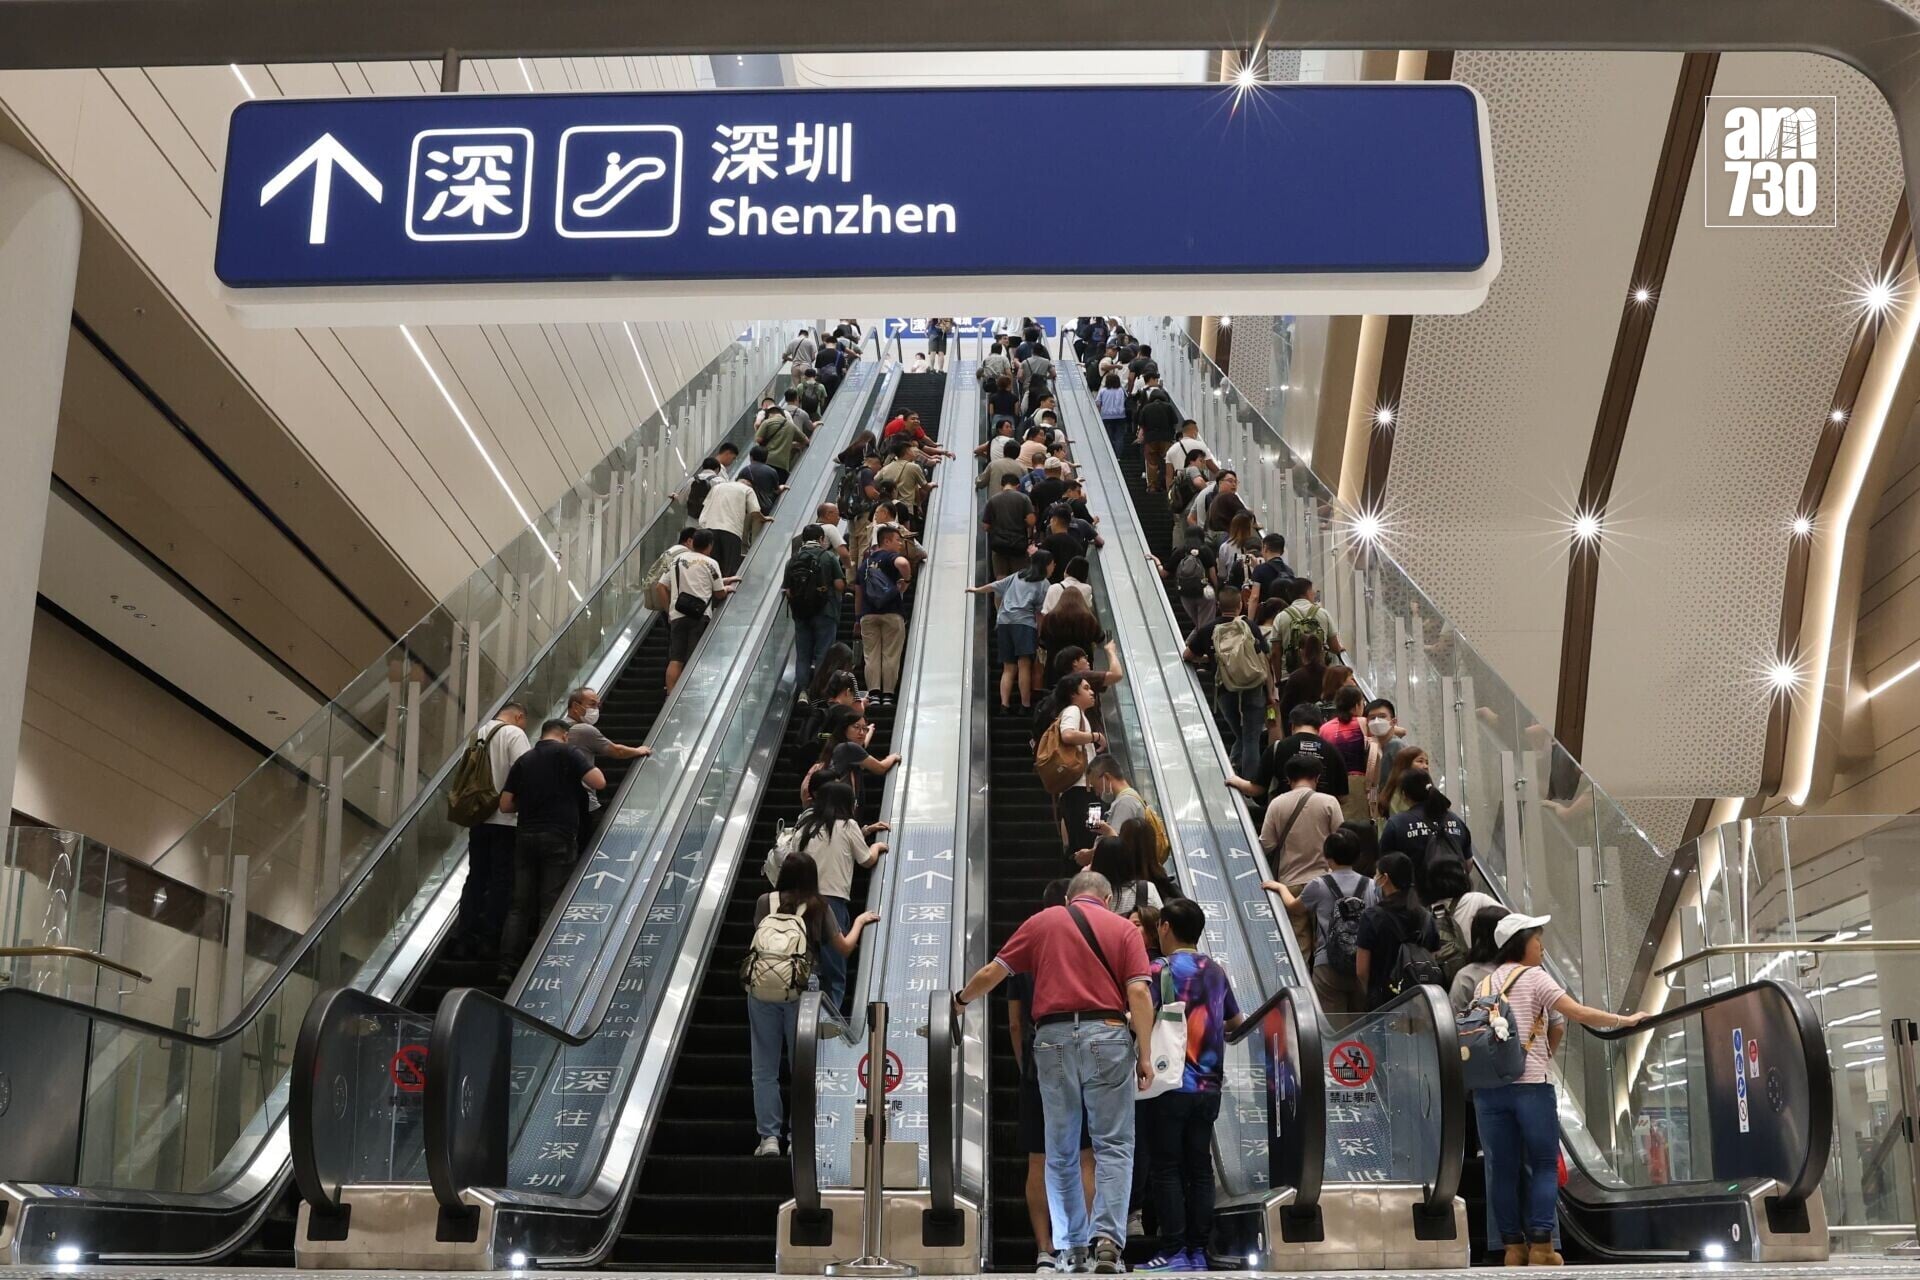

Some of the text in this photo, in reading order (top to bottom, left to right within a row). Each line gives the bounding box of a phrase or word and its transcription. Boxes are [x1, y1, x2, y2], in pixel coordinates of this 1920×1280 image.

[711, 122, 852, 184] 深圳
[424, 145, 513, 226] 深
[707, 194, 957, 236] Shenzhen
[907, 849, 954, 860] L4
[908, 906, 946, 920] 深
[560, 1070, 611, 1091] 深
[1329, 1092, 1377, 1103] 禁止攀爬
